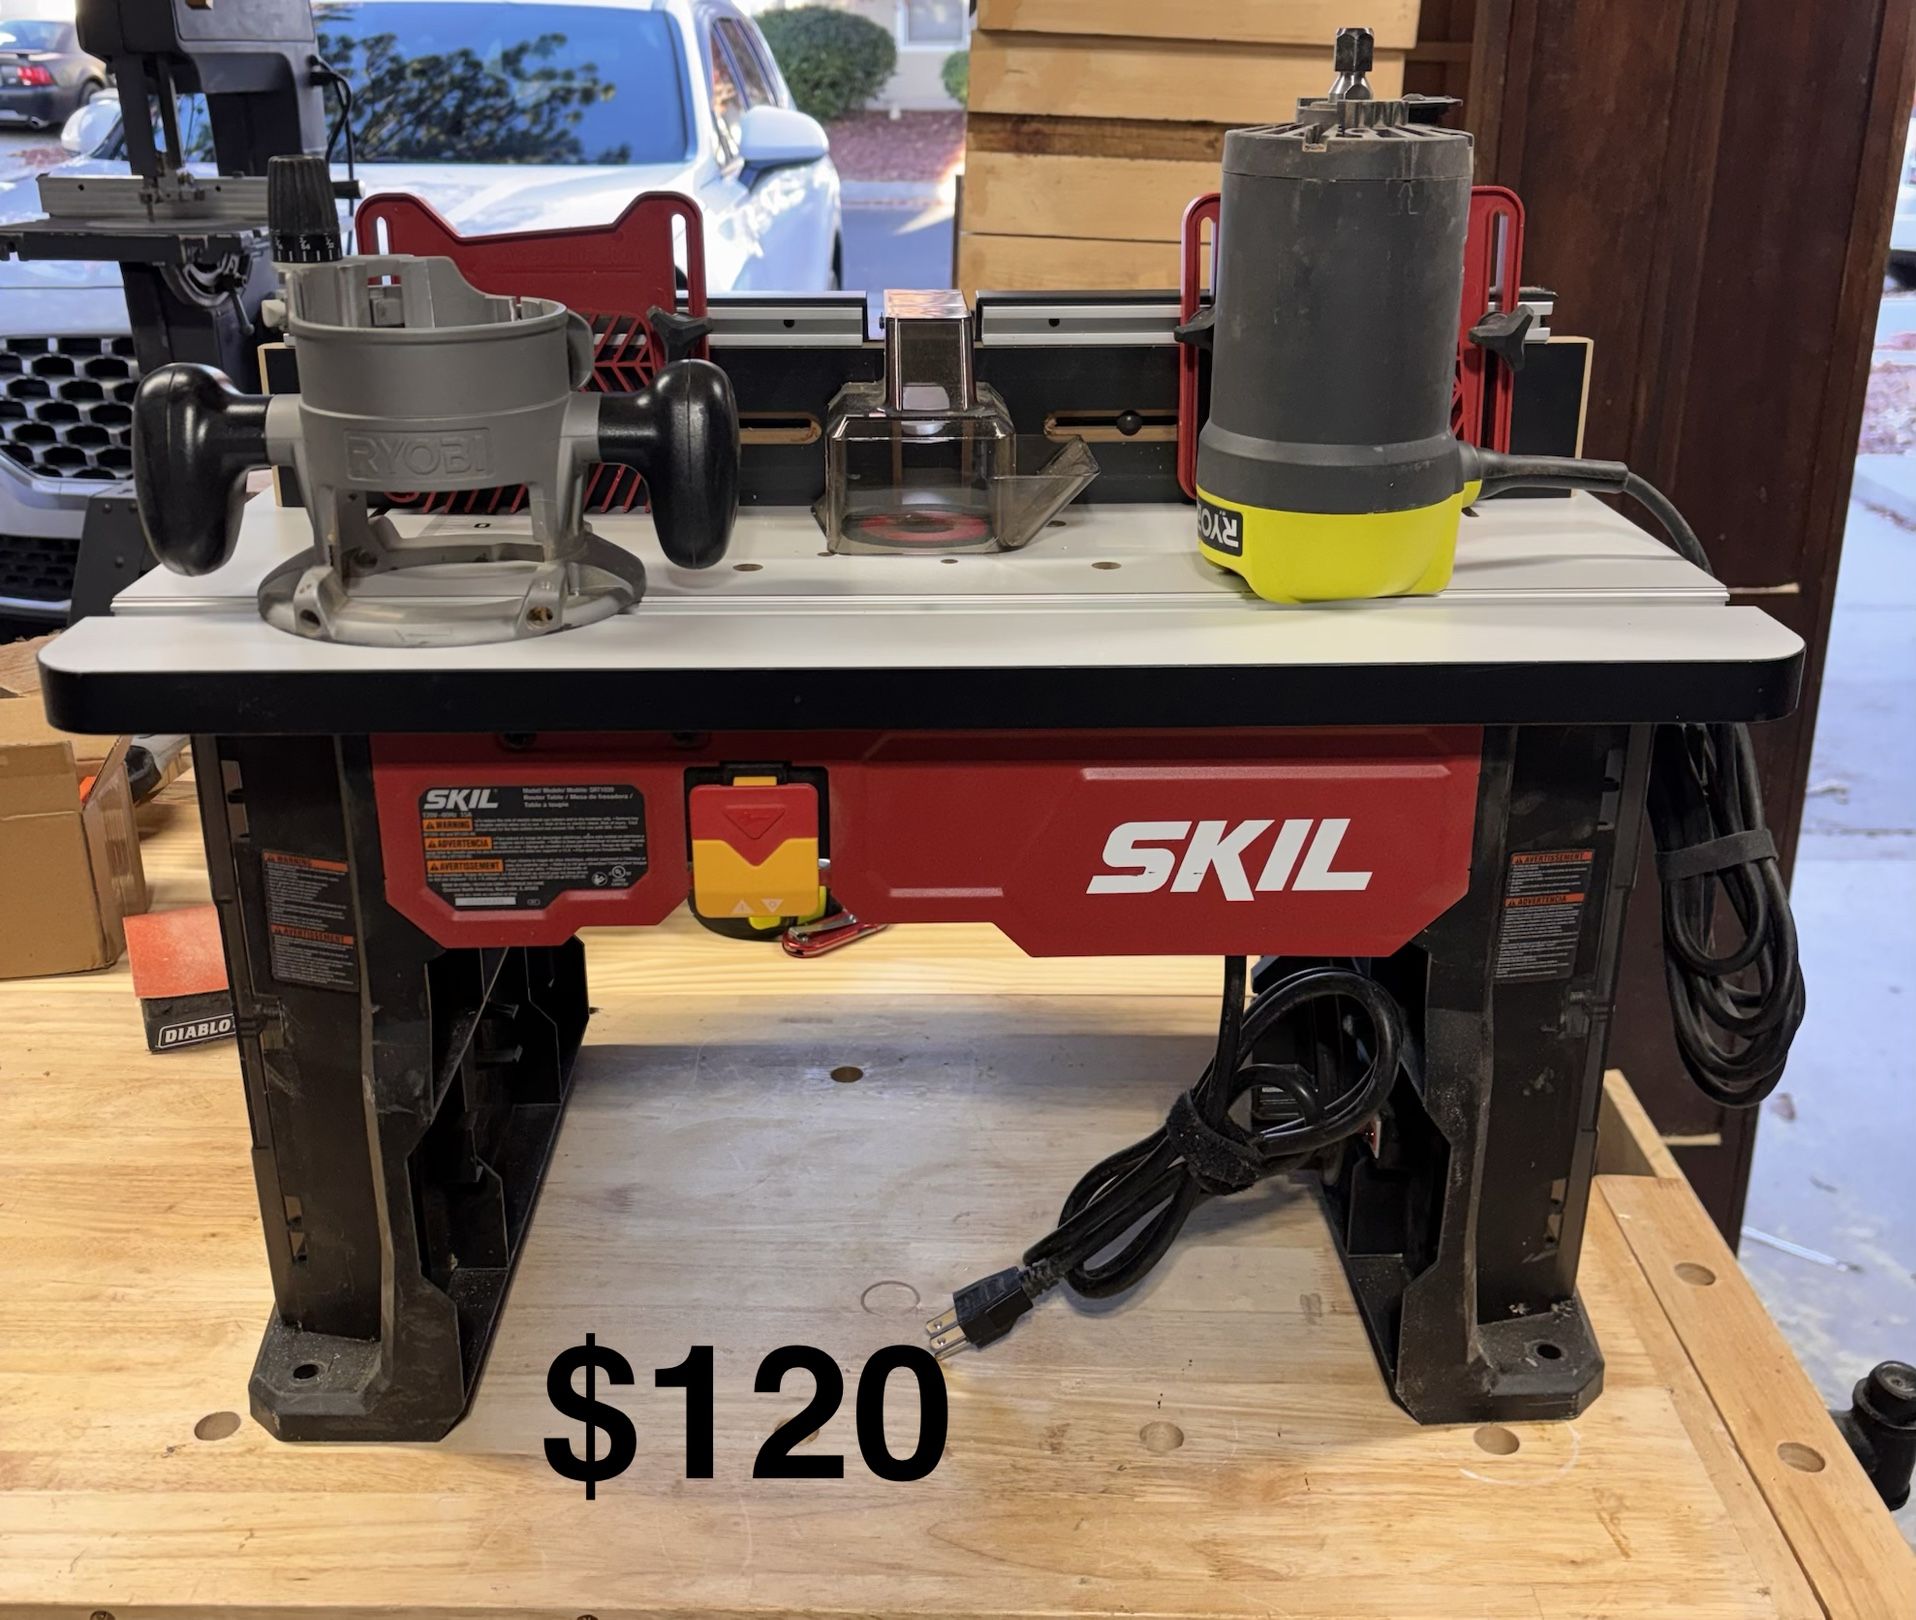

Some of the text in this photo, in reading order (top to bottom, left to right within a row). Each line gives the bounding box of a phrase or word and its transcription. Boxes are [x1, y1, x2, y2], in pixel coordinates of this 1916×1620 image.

[348, 434, 488, 476] RYOBI
[424, 788, 499, 811] SKIL
[436, 820, 470, 830] WARNING
[438, 839, 489, 850] ADVERTENCIA
[440, 861, 500, 872] AVERTISSEMENT
[1085, 818, 1374, 902] SKIL
[164, 1018, 231, 1043] DIABLO
